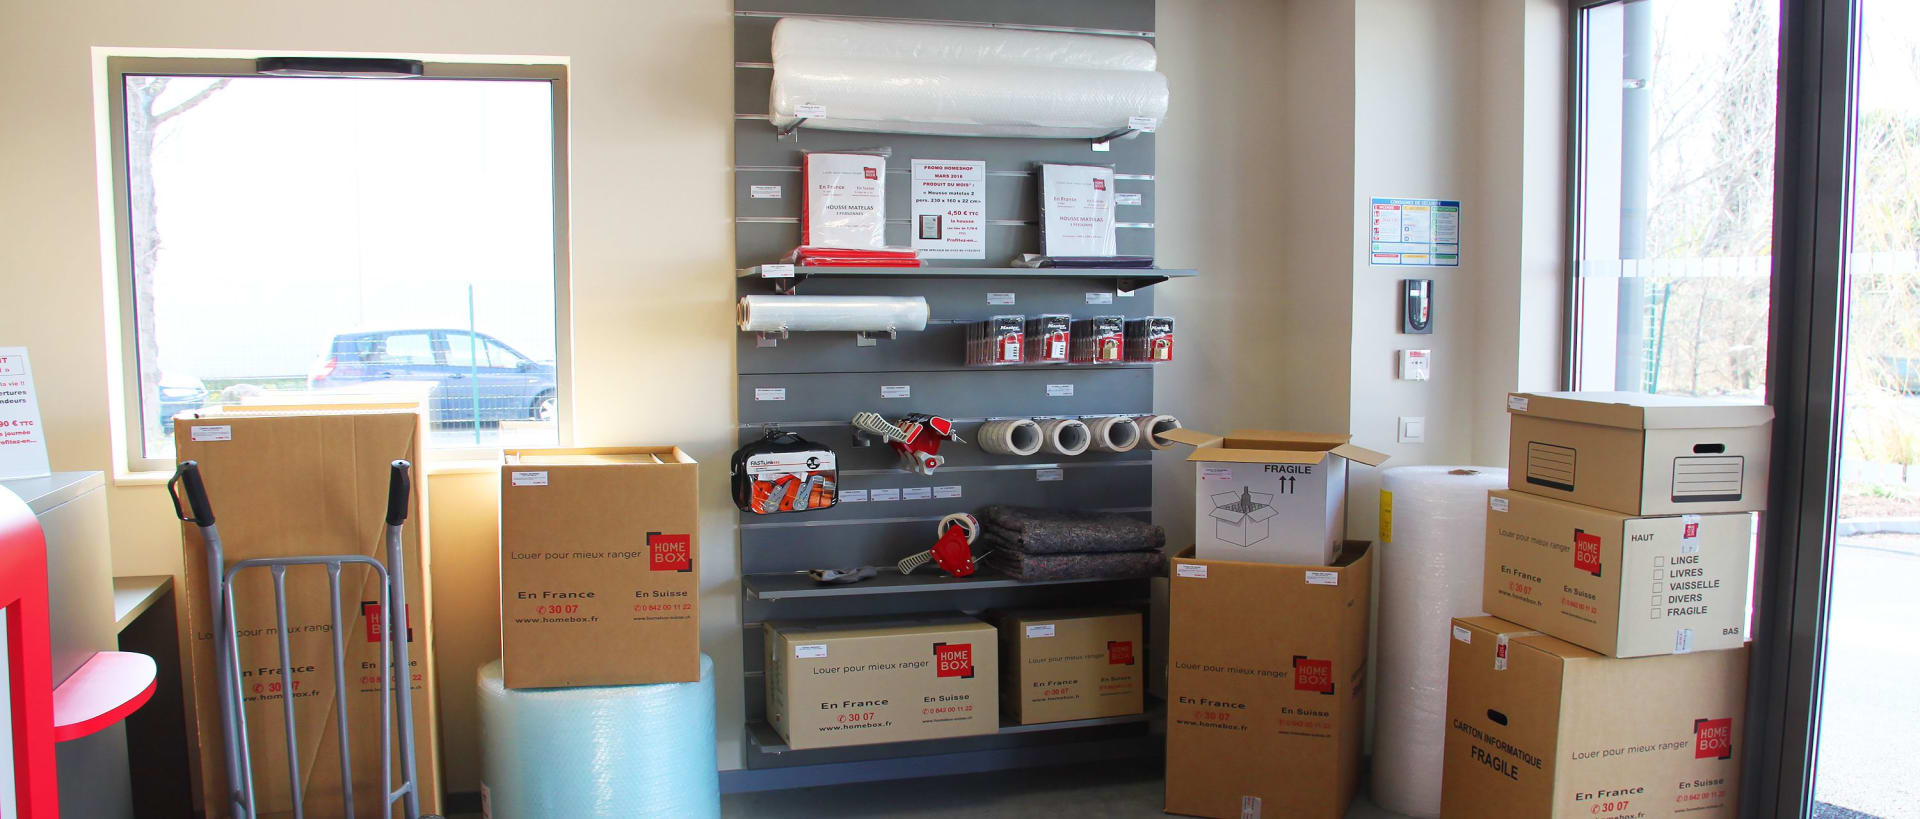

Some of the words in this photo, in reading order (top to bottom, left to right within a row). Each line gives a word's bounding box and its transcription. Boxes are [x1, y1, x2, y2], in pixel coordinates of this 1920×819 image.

[1264, 464, 1312, 475] FRAGILE
[1631, 534, 1654, 542] HAUT
[654, 542, 686, 553] HOME
[1578, 540, 1599, 554] HOME
[511, 550, 541, 560] Louer
[545, 551, 571, 562] pour
[573, 550, 604, 560] mieux
[608, 549, 642, 562] ranger
[654, 552, 688, 564] BOX
[1578, 552, 1598, 566] BOX
[1671, 555, 1700, 566] LINGE
[1501, 565, 1512, 575] En
[1513, 568, 1542, 584] France
[1670, 568, 1703, 579] LIVRES
[1670, 579, 1720, 592] VAISSELLE
[517, 591, 538, 600] En
[543, 590, 596, 600] France
[635, 590, 650, 598] En
[653, 589, 689, 598] Suisse
[1563, 585, 1574, 595] En
[1574, 588, 1597, 601] Suisse
[1668, 593, 1702, 604] DIVERS
[549, 604, 563, 614] 30
[565, 604, 580, 614] 07
[1667, 606, 1708, 617] FRAGILE
[514, 615, 600, 624] www.homebox.fr
[1722, 627, 1739, 636] BAS
[940, 650, 969, 661] HOME
[361, 661, 376, 669] En
[813, 666, 841, 675] Louer
[844, 664, 866, 675] pour
[868, 662, 897, 672] mieux
[899, 660, 930, 671] ranger
[940, 660, 970, 672] BOX
[1175, 661, 1200, 670] Louer
[1203, 664, 1225, 674] pour
[1228, 666, 1255, 676] mieux
[1257, 669, 1288, 680] ranger
[1299, 665, 1328, 676] HOME
[1047, 679, 1079, 687] France
[1299, 674, 1327, 686] BOX
[938, 693, 970, 702] Suisse
[1179, 696, 1196, 705] En
[1200, 698, 1248, 710] France
[820, 702, 838, 710] En
[842, 699, 890, 708] France
[848, 712, 860, 722] 30
[862, 711, 876, 721] 07
[1281, 706, 1294, 715] En
[1296, 708, 1330, 718] Suisse
[818, 719, 893, 732] www.homebox.fr
[1700, 726, 1729, 740] HOME
[1453, 719, 1482, 741] CARTON
[1484, 734, 1544, 771] INFORMATIQUE
[1571, 750, 1600, 761] Louer
[1602, 748, 1626, 758] pour
[1627, 744, 1656, 755] mieux
[1657, 740, 1690, 752] ranger
[1699, 738, 1728, 752] BOX
[1471, 745, 1520, 781] FRAGILE
[1678, 781, 1691, 790] En
[1693, 778, 1725, 788] Suisse
[1575, 792, 1593, 802] En
[1597, 785, 1645, 799] France
[1601, 801, 1614, 813] 30
[1616, 800, 1630, 812] 07
